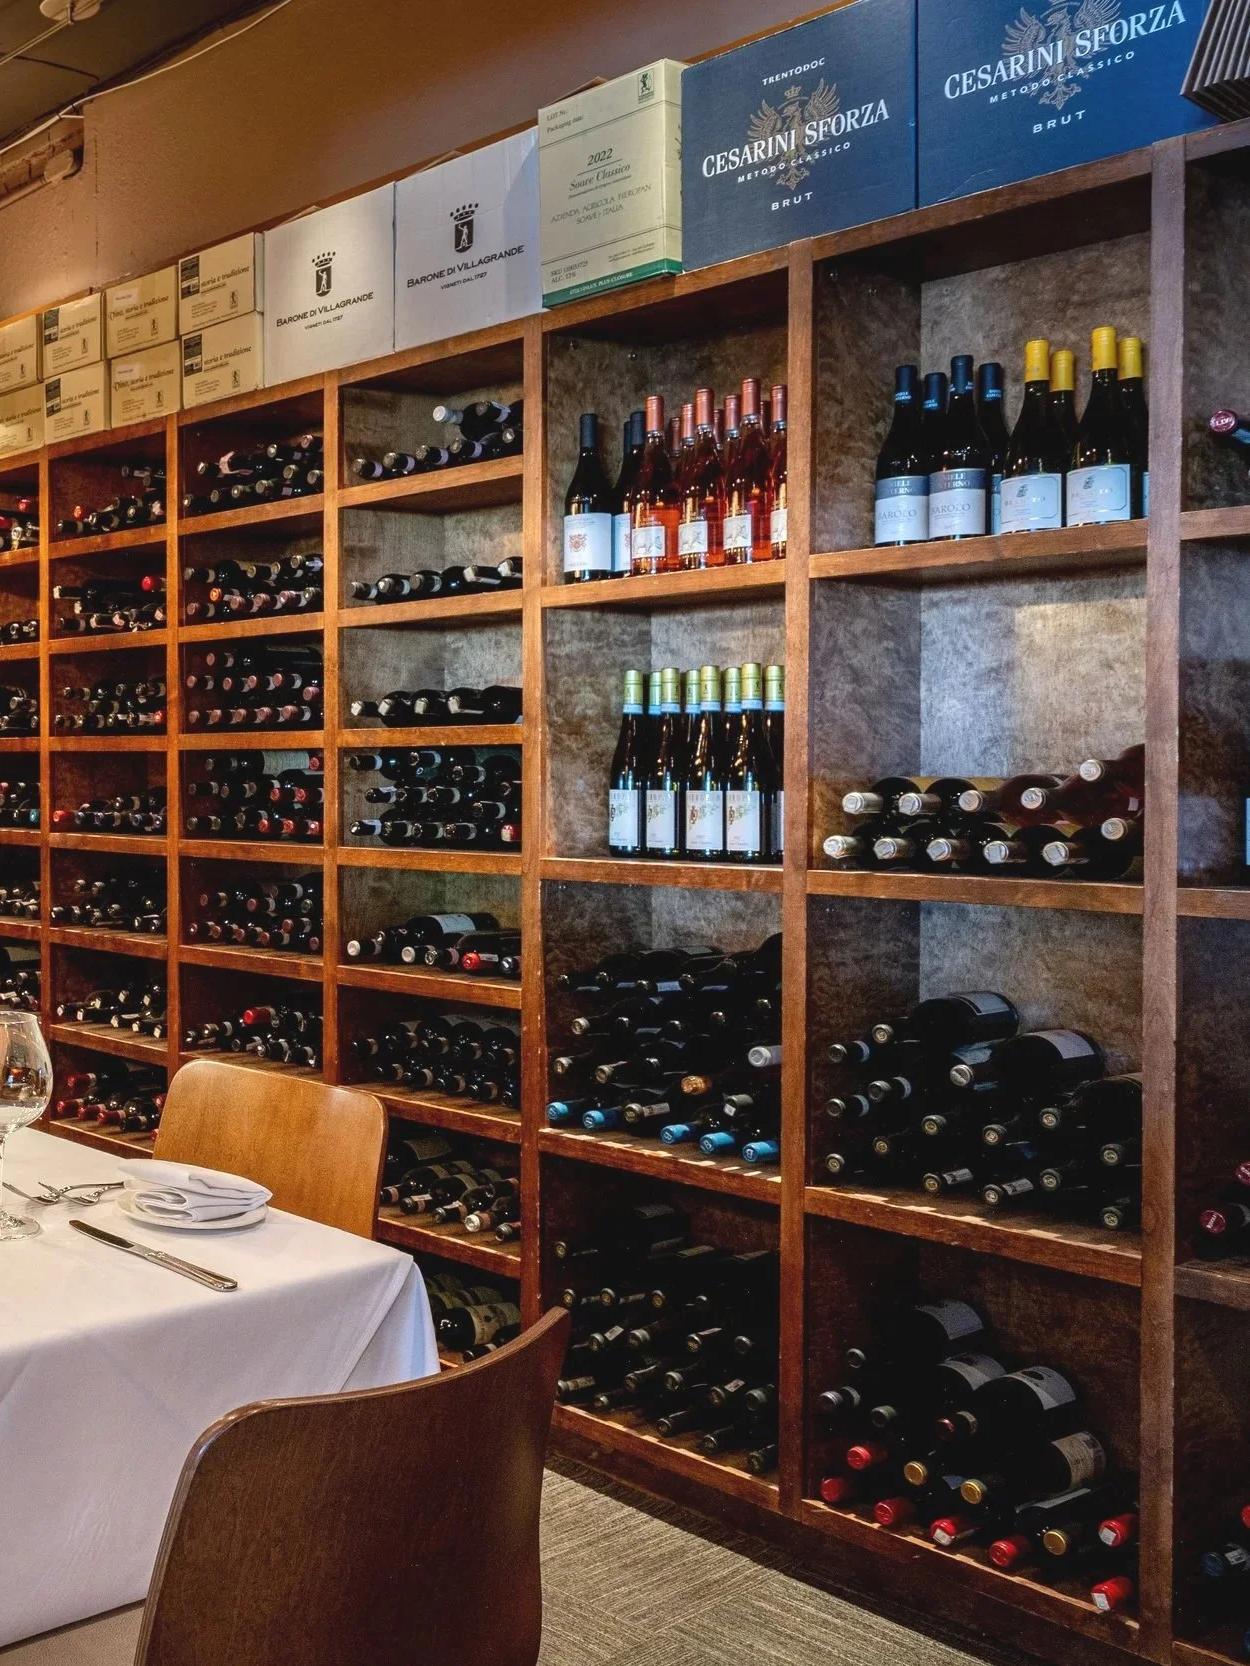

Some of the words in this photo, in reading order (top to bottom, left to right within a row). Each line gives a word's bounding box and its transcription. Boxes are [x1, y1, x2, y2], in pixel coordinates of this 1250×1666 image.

[944, 39, 1064, 99] CESARINI
[1075, 0, 1186, 57] SFORZA
[762, 57, 826, 86] TRENTODOC
[989, 78, 1051, 104] METODO
[1057, 51, 1135, 82] CLASSICO
[1032, 110, 1086, 134] BRUT
[702, 129, 796, 178] CESARINI
[804, 99, 889, 145] SFORZA
[587, 148, 613, 166] 2022
[737, 162, 786, 184] METODO
[790, 142, 851, 167] CLASSICO
[596, 163, 631, 181] Classico
[771, 192, 813, 211] BRUT
[551, 208, 579, 223] AZIENDA
[406, 269, 446, 288] BARONE
[446, 266, 456, 277] DI
[456, 244, 525, 273] VILLAGRANDE
[440, 281, 463, 290] VIGNETI
[463, 276, 474, 285] DAL
[474, 271, 488, 280] 1727
[276, 311, 309, 328] BARONE
[310, 308, 317, 318] DI
[317, 291, 374, 315] VILLAGRANDE
[323, 319, 332, 327] DAL
[332, 314, 344, 322] 1727
